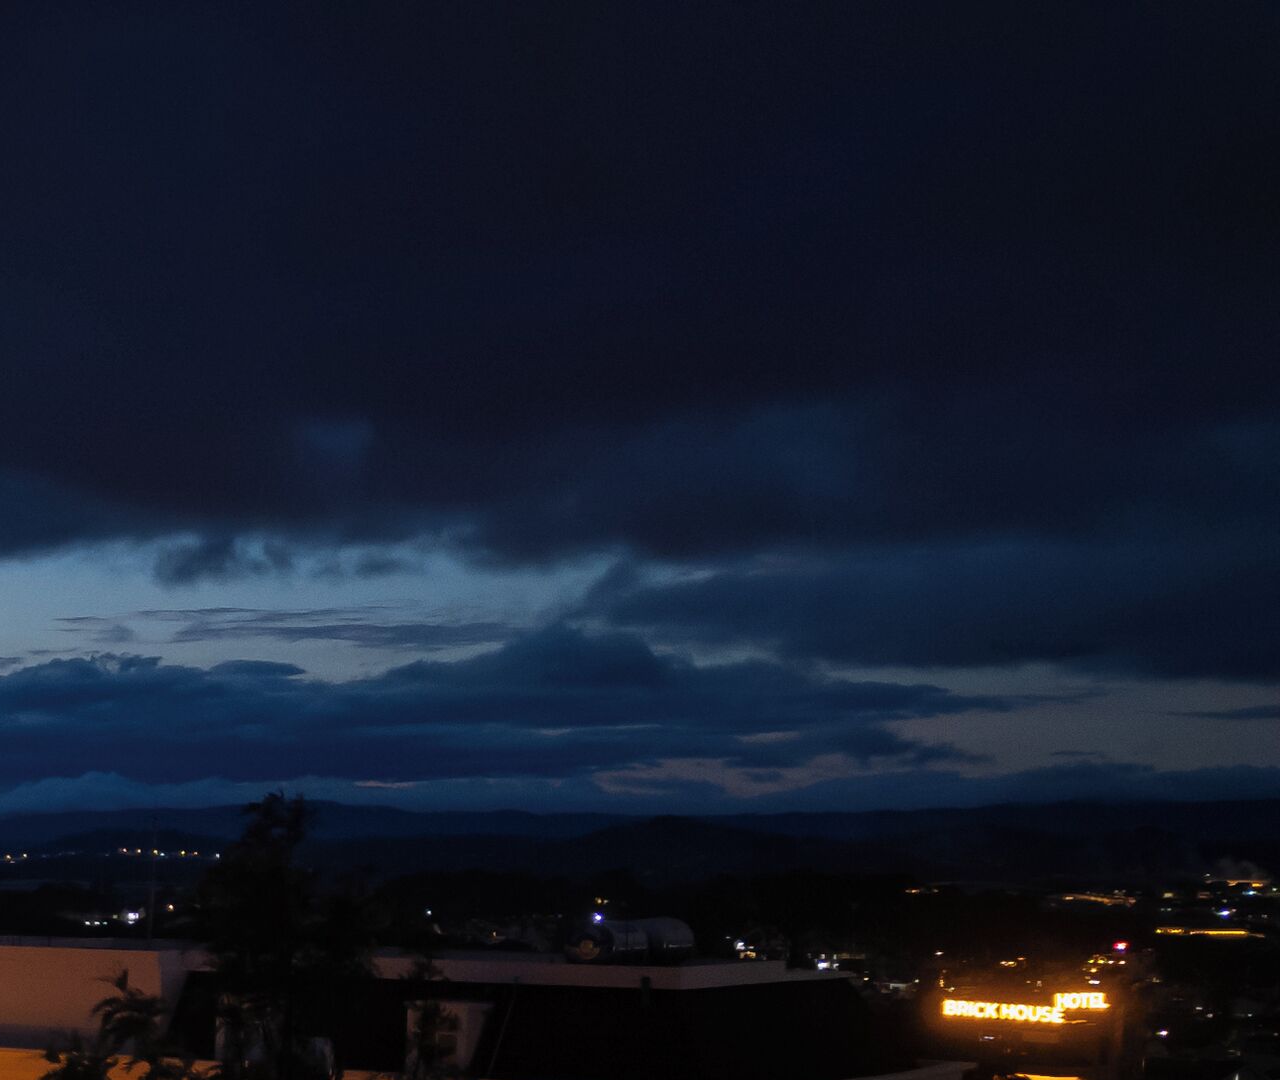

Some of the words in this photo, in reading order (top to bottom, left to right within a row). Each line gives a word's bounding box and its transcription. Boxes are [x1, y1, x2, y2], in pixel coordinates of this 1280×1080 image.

[942, 999, 999, 1019] BRICK
[999, 1003, 1065, 1023] HOUSE
[1054, 992, 1110, 1010] HOTEL
